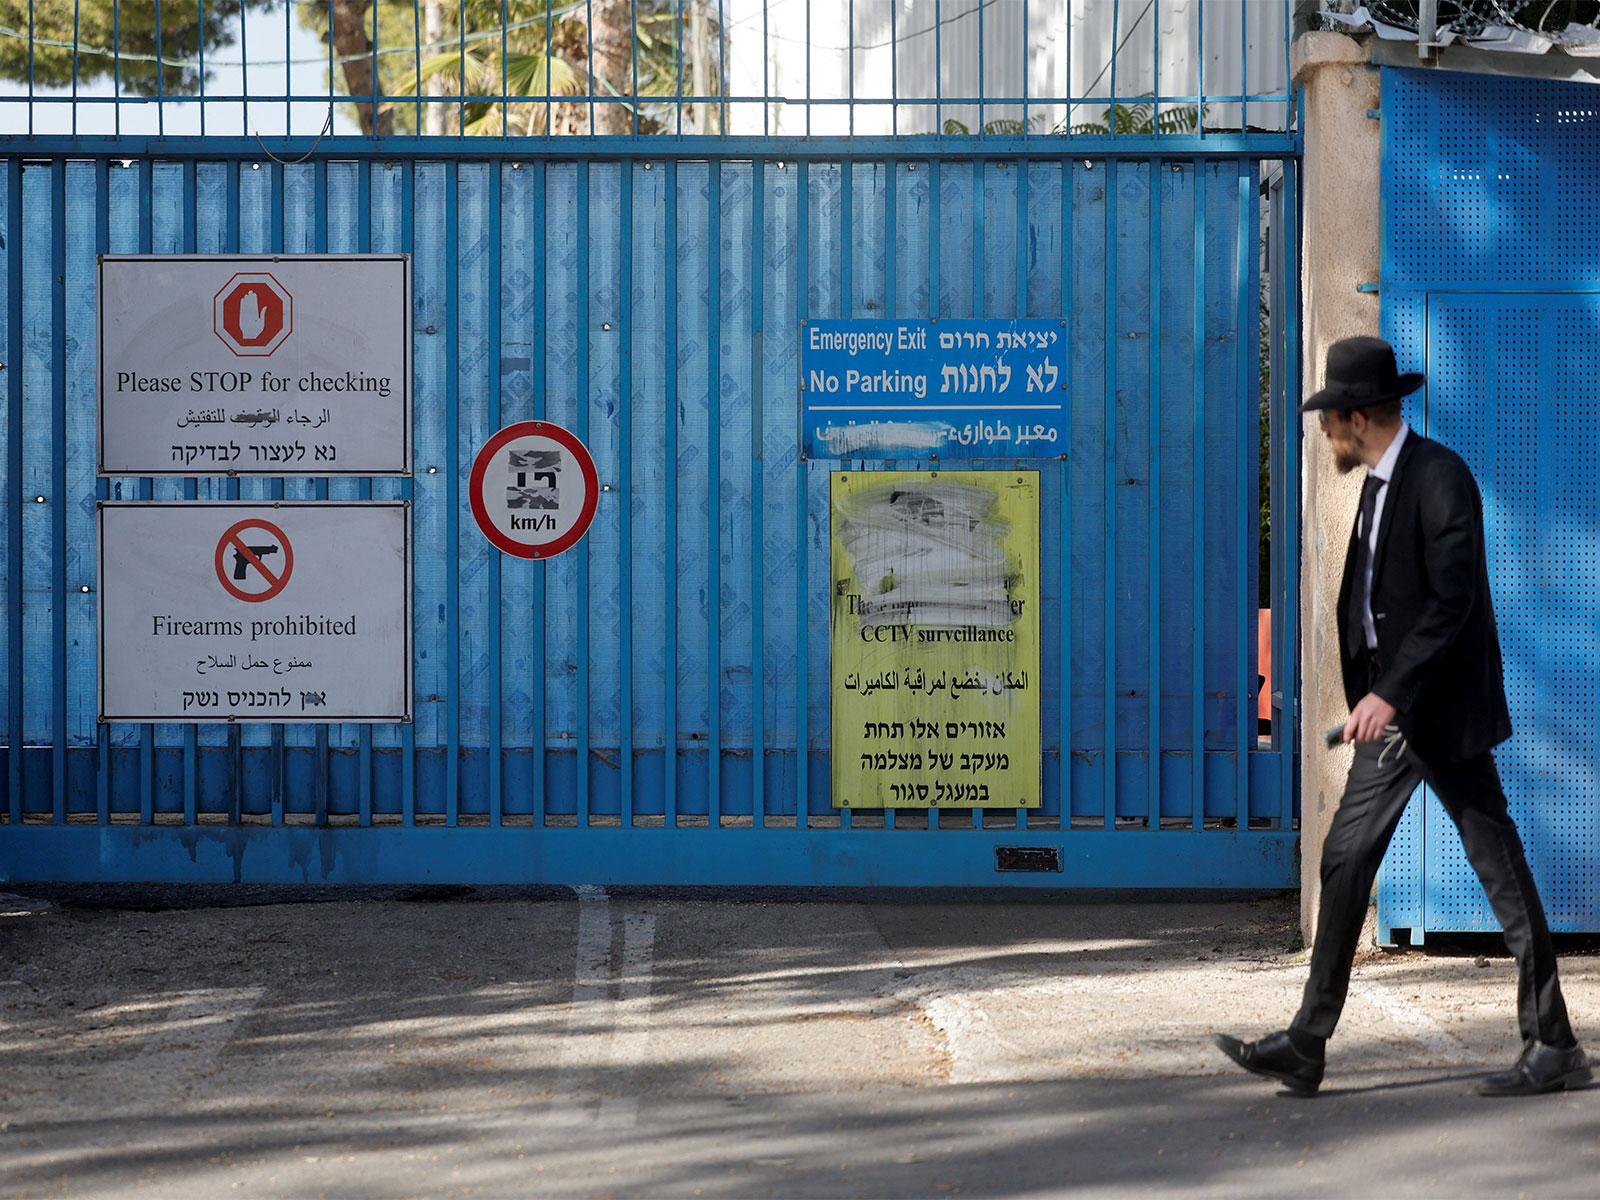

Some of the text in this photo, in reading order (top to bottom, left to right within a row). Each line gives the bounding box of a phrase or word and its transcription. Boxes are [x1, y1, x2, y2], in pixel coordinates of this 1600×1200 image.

[811, 327, 926, 355] Emergency Exit
[939, 331, 1058, 348] יציאת חרום
[118, 372, 390, 397] Please STOP for checking
[811, 370, 926, 398] No Parking
[941, 357, 1058, 392] לא לחנות
[177, 409, 225, 427] للتفتيش
[287, 409, 329, 428] الرجاء
[1016, 425, 1057, 444] معبر
[172, 441, 335, 465] נא לעצור לבדיקה
[511, 515, 555, 531] km/h
[154, 616, 355, 640] Firearms prohibited
[861, 625, 913, 642] CCTV
[197, 655, 312, 674] ممنوع حمل السلاح
[845, 667, 1028, 699] المكان يخضع لمراقبة الكاميرات
[183, 692, 218, 710] נשק
[227, 687, 291, 706] להכניס
[864, 718, 1005, 738] אזורים אלו תחת
[861, 749, 1008, 774] מעקב של מצלמה
[890, 780, 989, 802] במעגל סגור
